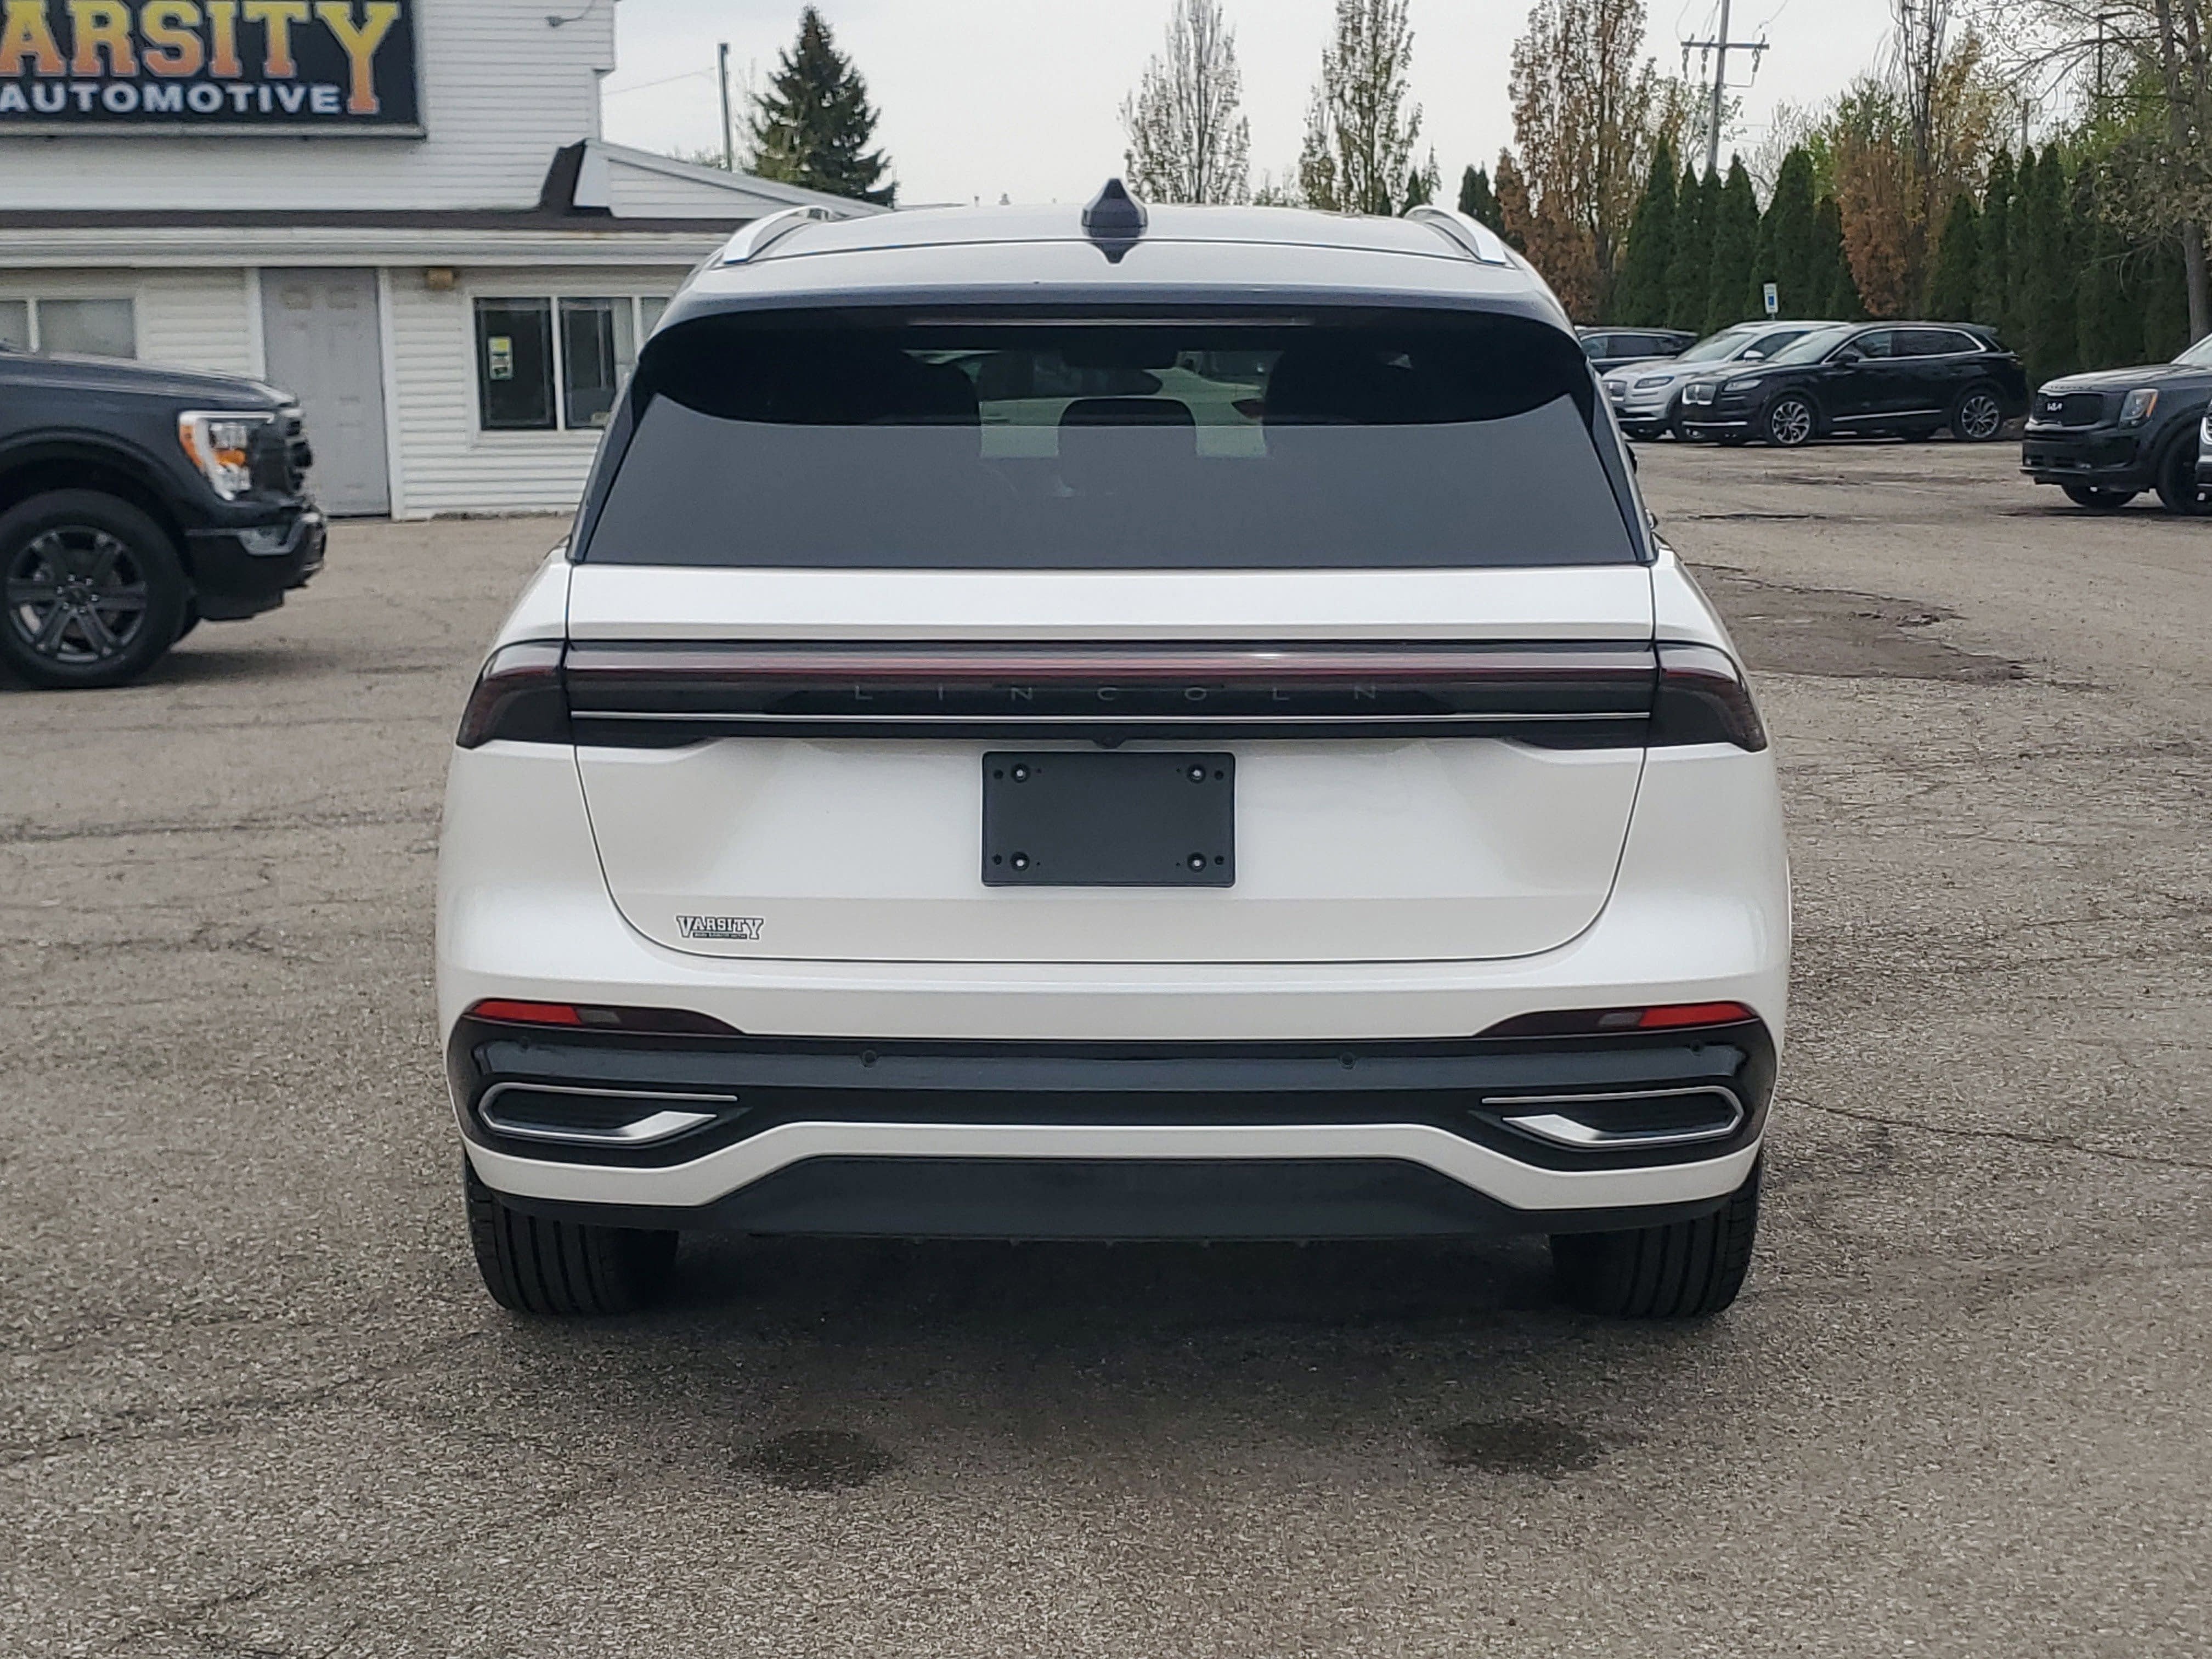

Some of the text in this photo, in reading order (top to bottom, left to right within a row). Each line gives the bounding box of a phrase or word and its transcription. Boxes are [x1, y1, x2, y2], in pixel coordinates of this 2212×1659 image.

[0, 0, 399, 115] ARSITY
[0, 83, 341, 113] AUTOMOTIVE
[855, 685, 1376, 701] LINCOLN
[676, 916, 764, 940] VARSITY
